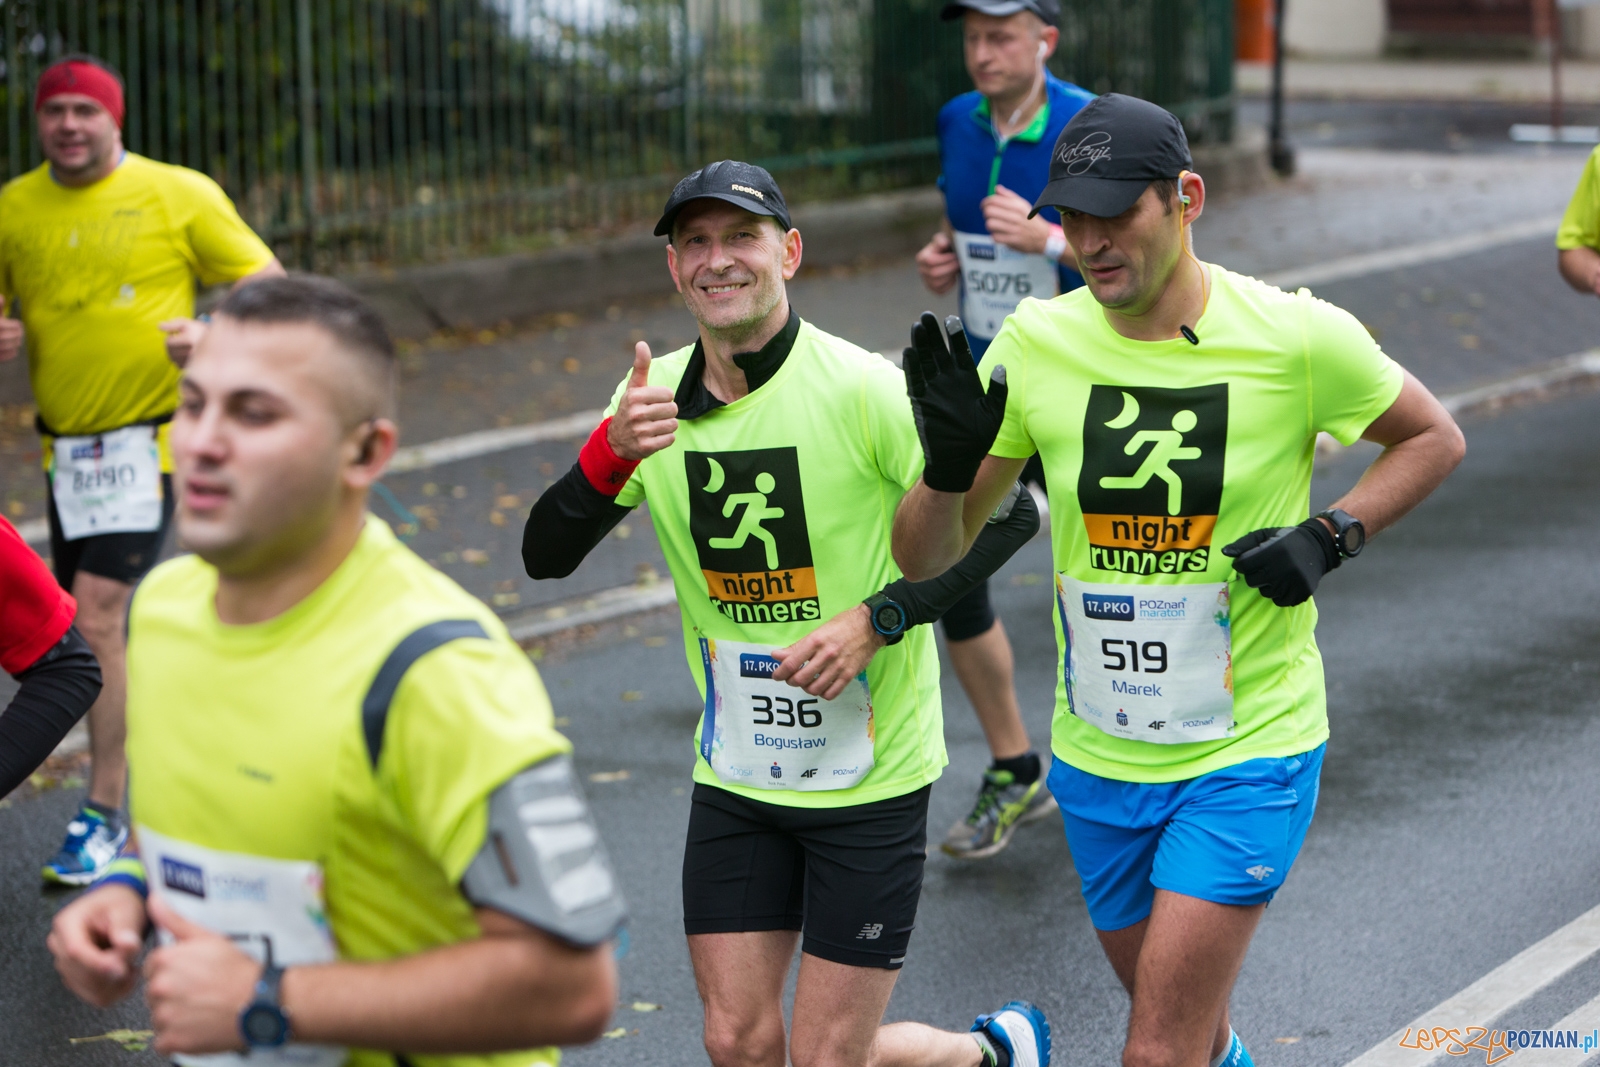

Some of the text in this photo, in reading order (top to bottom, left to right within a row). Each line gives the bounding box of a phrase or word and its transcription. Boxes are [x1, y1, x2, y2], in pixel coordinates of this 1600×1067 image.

[1056, 131, 1112, 175] Kalenji
[732, 184, 764, 200] Reebok
[967, 270, 1032, 294] 5076
[1112, 515, 1192, 549] night
[1091, 547, 1207, 574] runners
[722, 571, 795, 602] night
[1139, 609, 1185, 617] maraton
[1101, 638, 1168, 673] 519
[1112, 680, 1163, 697] Marek
[751, 695, 823, 728] 336
[754, 733, 827, 750] Bogusław
